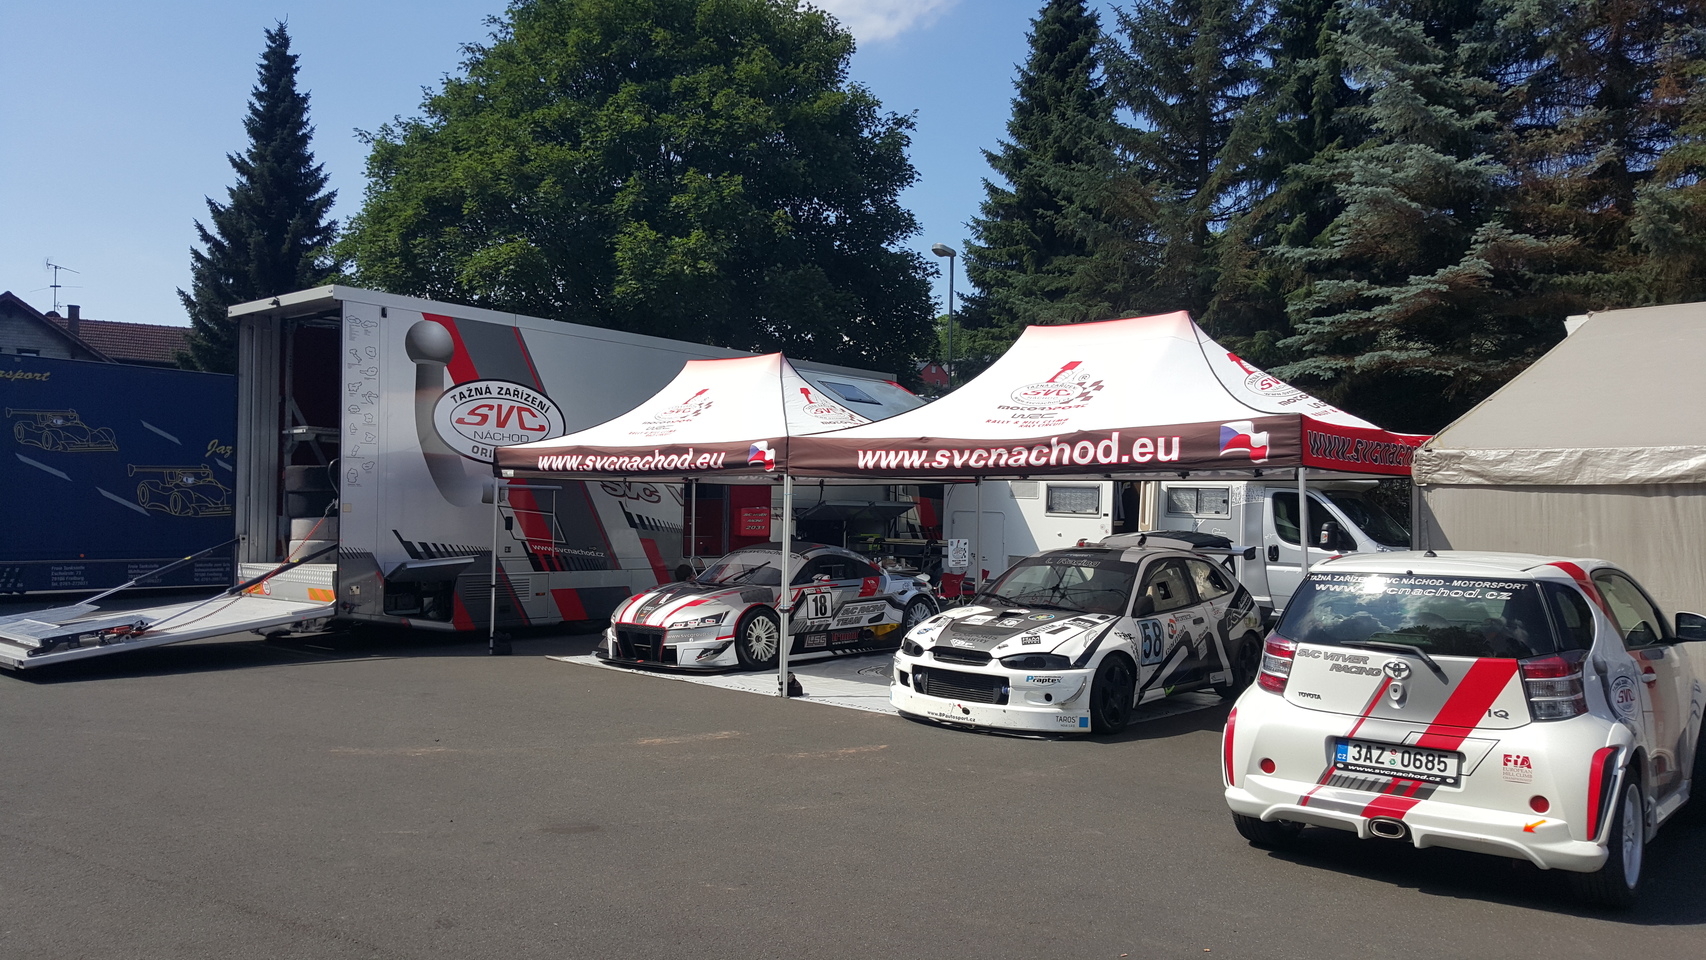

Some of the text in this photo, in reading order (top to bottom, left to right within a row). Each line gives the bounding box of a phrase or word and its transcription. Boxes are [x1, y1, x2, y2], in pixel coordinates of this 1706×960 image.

[450, 384, 551, 414] TAŽNÁ ZAŘÍZENÍ
[1022, 389, 1071, 397] SVC
[455, 403, 546, 433] SVC
[473, 430, 530, 443] NÁCHOD
[857, 431, 1181, 470] www.svcnachod.eu
[537, 447, 726, 473] www.svcnachod.eu
[531, 544, 605, 558] wwwsvcnachod.cz
[1333, 573, 1370, 583] ZAŘÍZE
[1401, 576, 1444, 587] NÁCHOD
[1452, 580, 1528, 590] MOTORSPORT
[1314, 583, 1512, 600] www.cnachod.cz
[812, 594, 828, 616] 18
[1141, 621, 1162, 660] 58
[1297, 648, 1370, 665] SVC VITVER
[1329, 663, 1383, 677] RACING
[1026, 674, 1064, 685] Praptex
[1297, 691, 1322, 700] TOYOTA
[1617, 688, 1635, 704] SVC
[1055, 715, 1076, 724] TAROS
[1351, 743, 1449, 773] 3AZ 0685
[1348, 765, 1442, 782] www.svcnachod.cz
